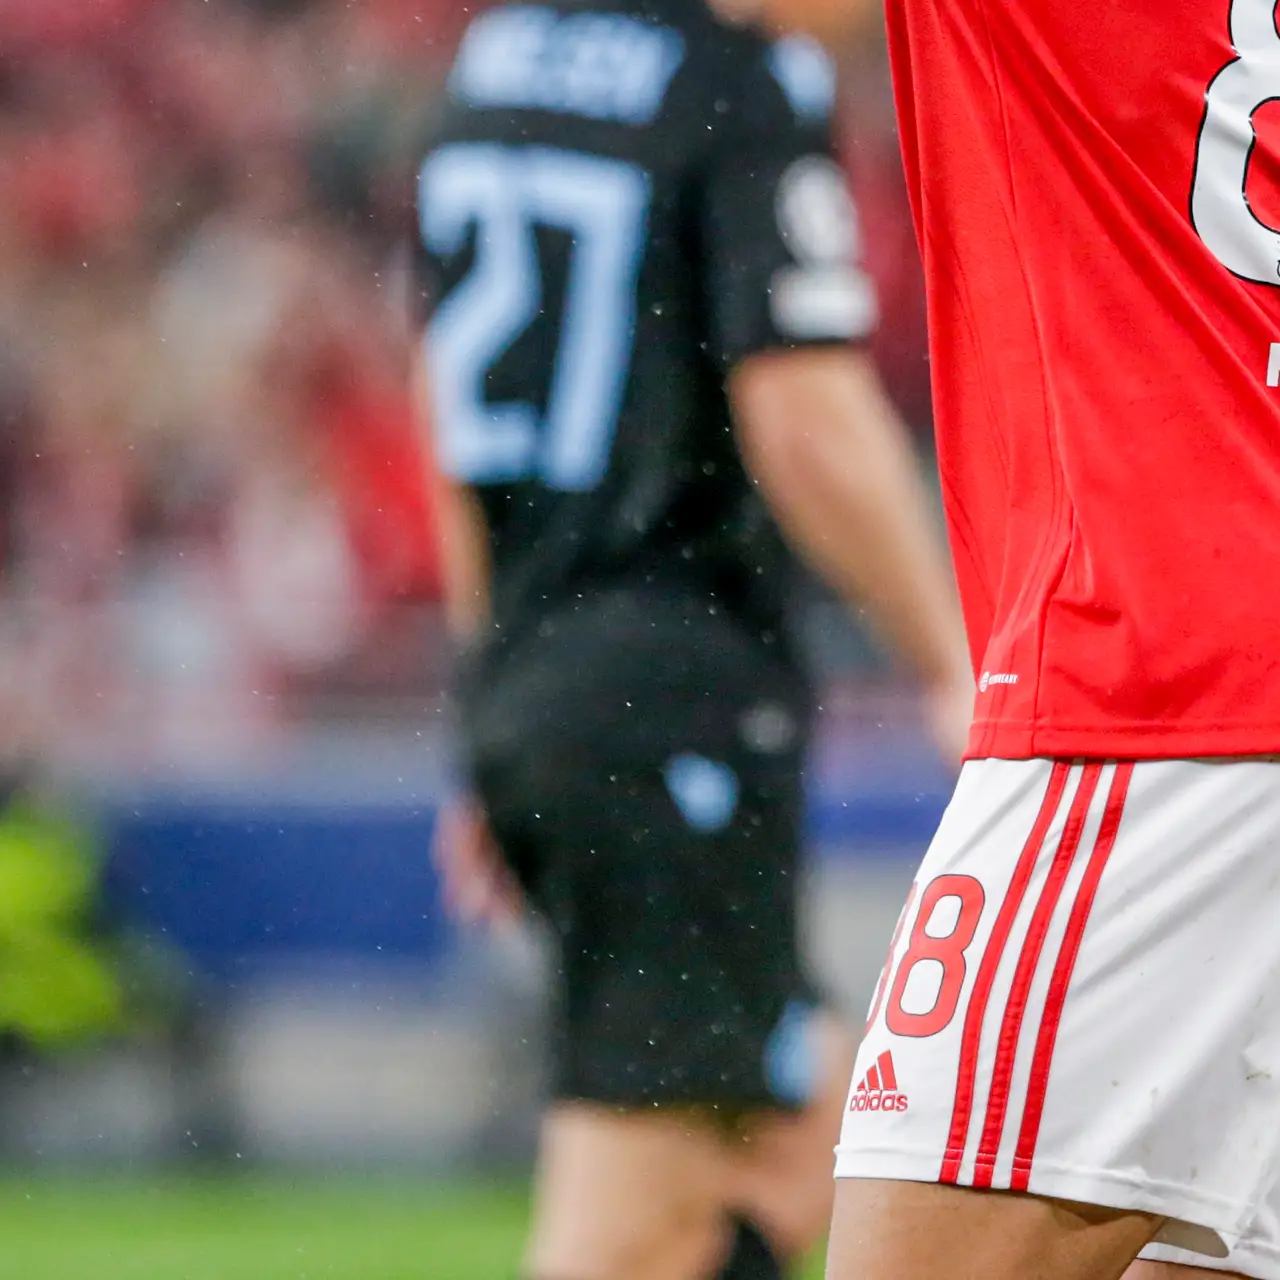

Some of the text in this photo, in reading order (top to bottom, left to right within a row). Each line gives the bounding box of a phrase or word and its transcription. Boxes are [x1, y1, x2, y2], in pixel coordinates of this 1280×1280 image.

[419, 140, 654, 493] 27
[864, 873, 985, 1038] 8
[849, 1089, 908, 1112] adidas
